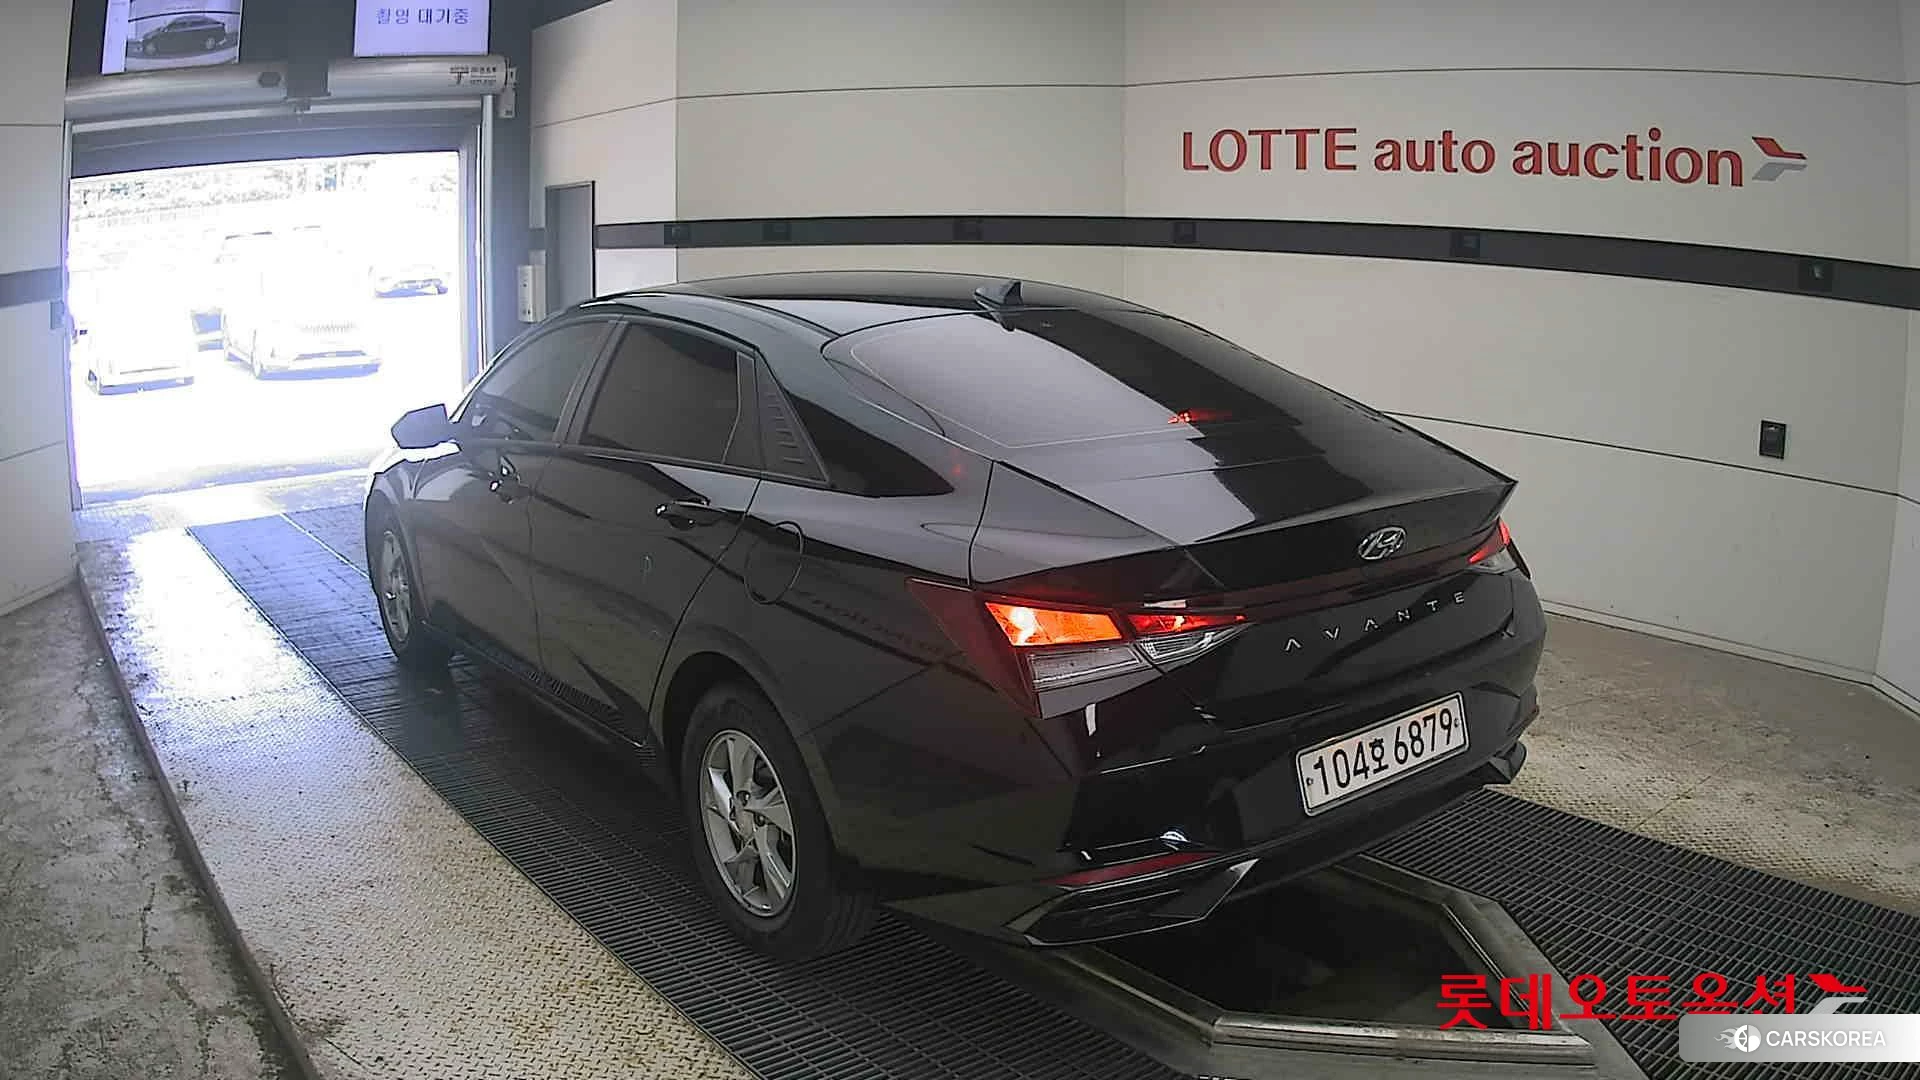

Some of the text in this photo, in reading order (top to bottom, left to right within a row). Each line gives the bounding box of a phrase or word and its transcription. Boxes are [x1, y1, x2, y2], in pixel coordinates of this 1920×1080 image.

[418, 8, 468, 24] 대기중
[1182, 127, 1743, 187] LOTTE auto auction
[1284, 591, 1465, 652] AVANTE
[1313, 708, 1453, 795] 104호 6879
